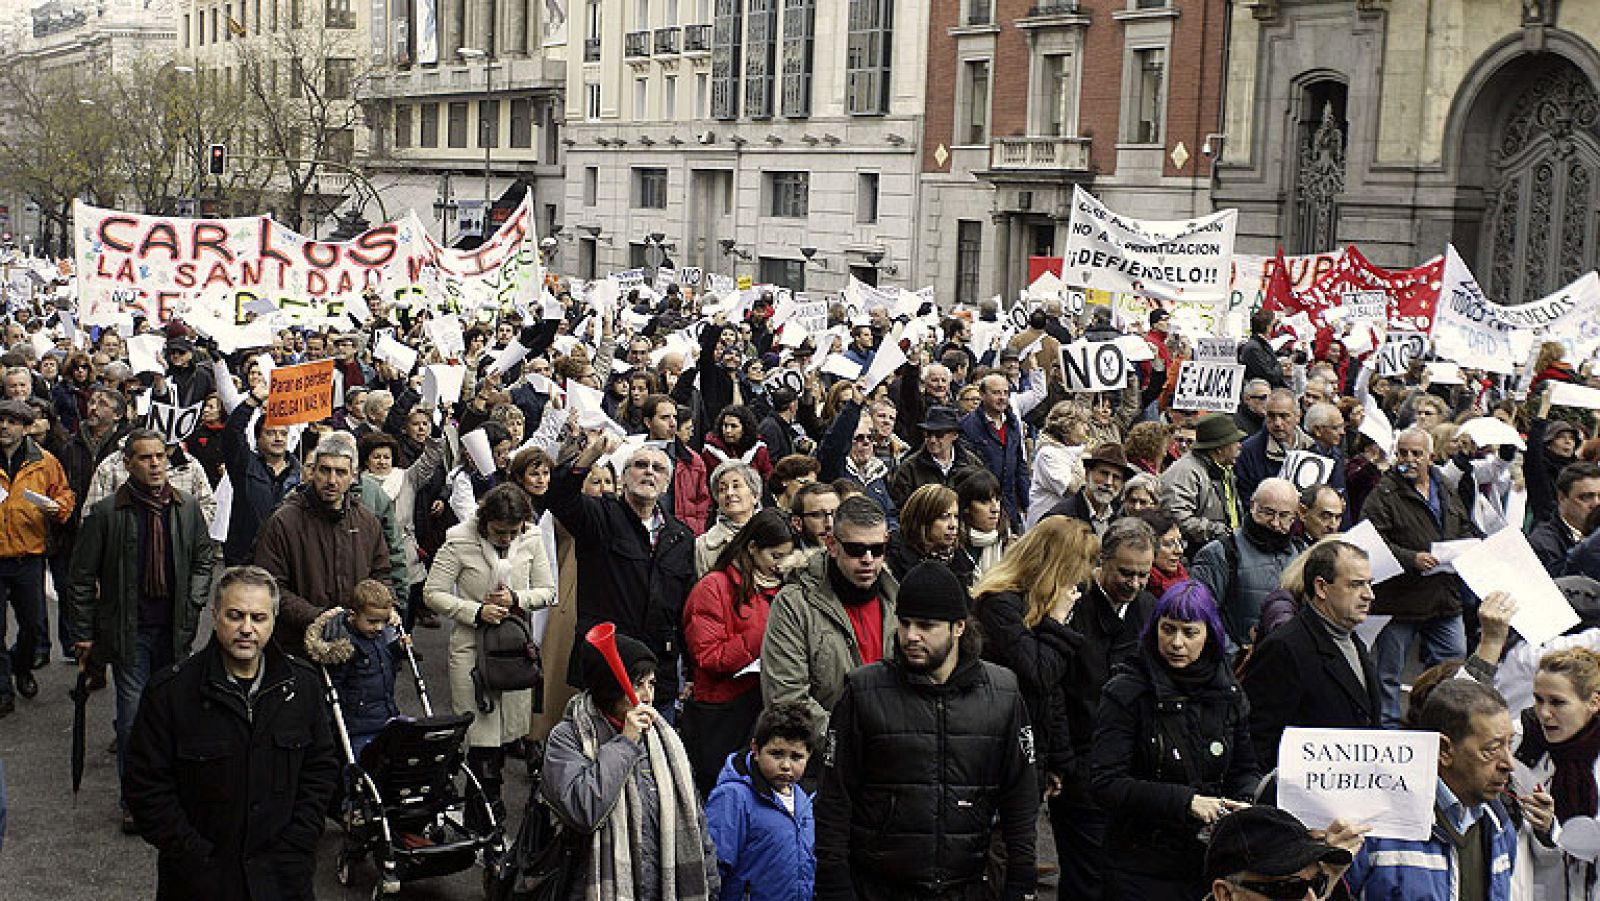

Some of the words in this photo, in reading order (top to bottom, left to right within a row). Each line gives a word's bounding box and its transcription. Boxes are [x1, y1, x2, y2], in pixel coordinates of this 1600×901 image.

[97, 215, 399, 270] CARLOS
[1072, 222, 1092, 236] NO
[97, 253, 137, 284] LA
[681, 268, 701, 284] NO
[1062, 343, 1124, 389] NO
[150, 404, 197, 443] NO
[1302, 741, 1413, 764] SANIDAD
[1305, 767, 1409, 792] PÚBLICA
